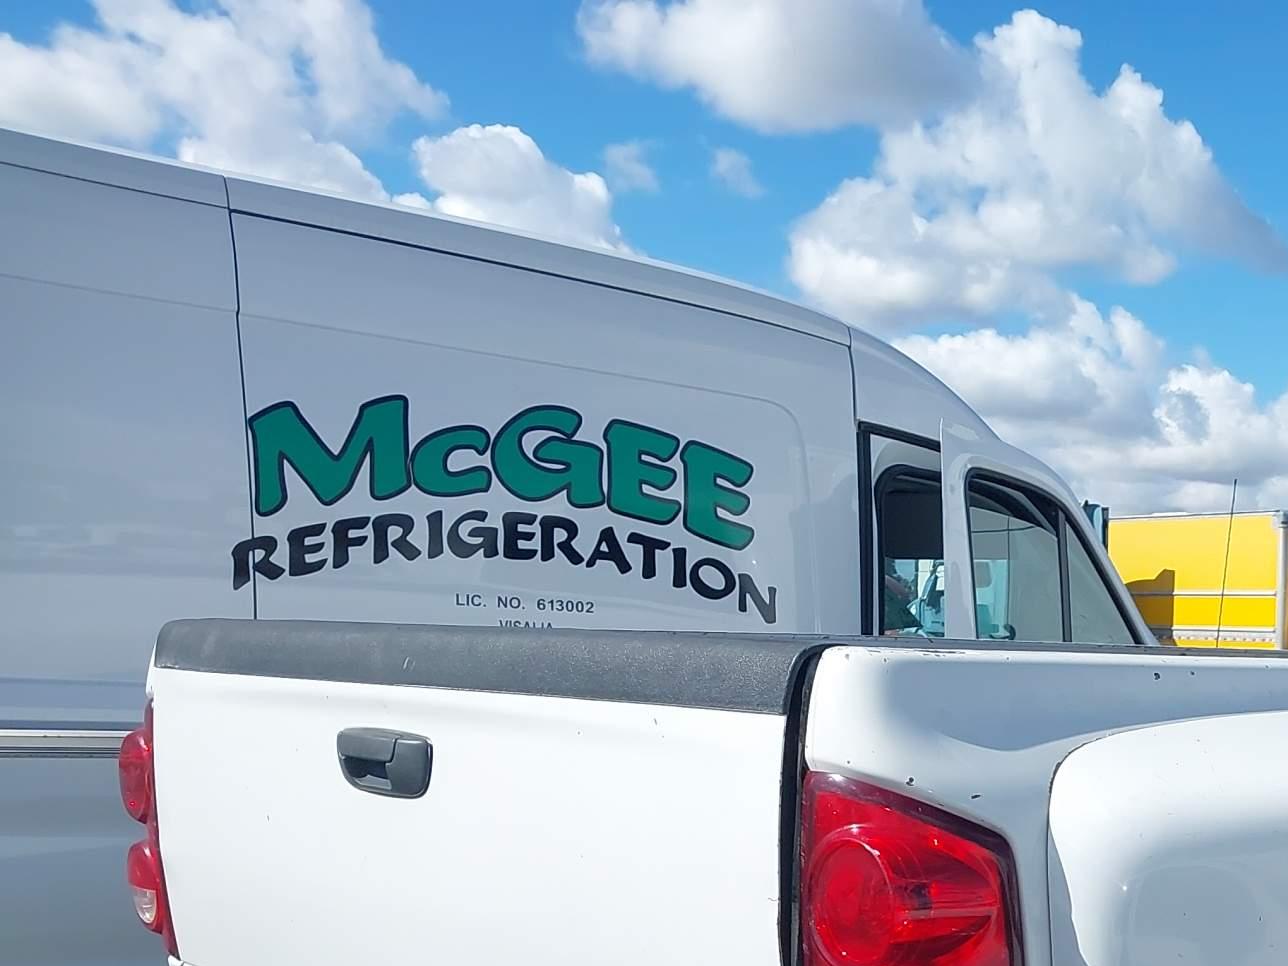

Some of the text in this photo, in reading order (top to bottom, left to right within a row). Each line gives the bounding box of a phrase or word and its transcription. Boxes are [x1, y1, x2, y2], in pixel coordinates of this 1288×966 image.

[232, 510, 777, 624] REFRIGERATION
[455, 593, 595, 614] LIC. NO. 613002
